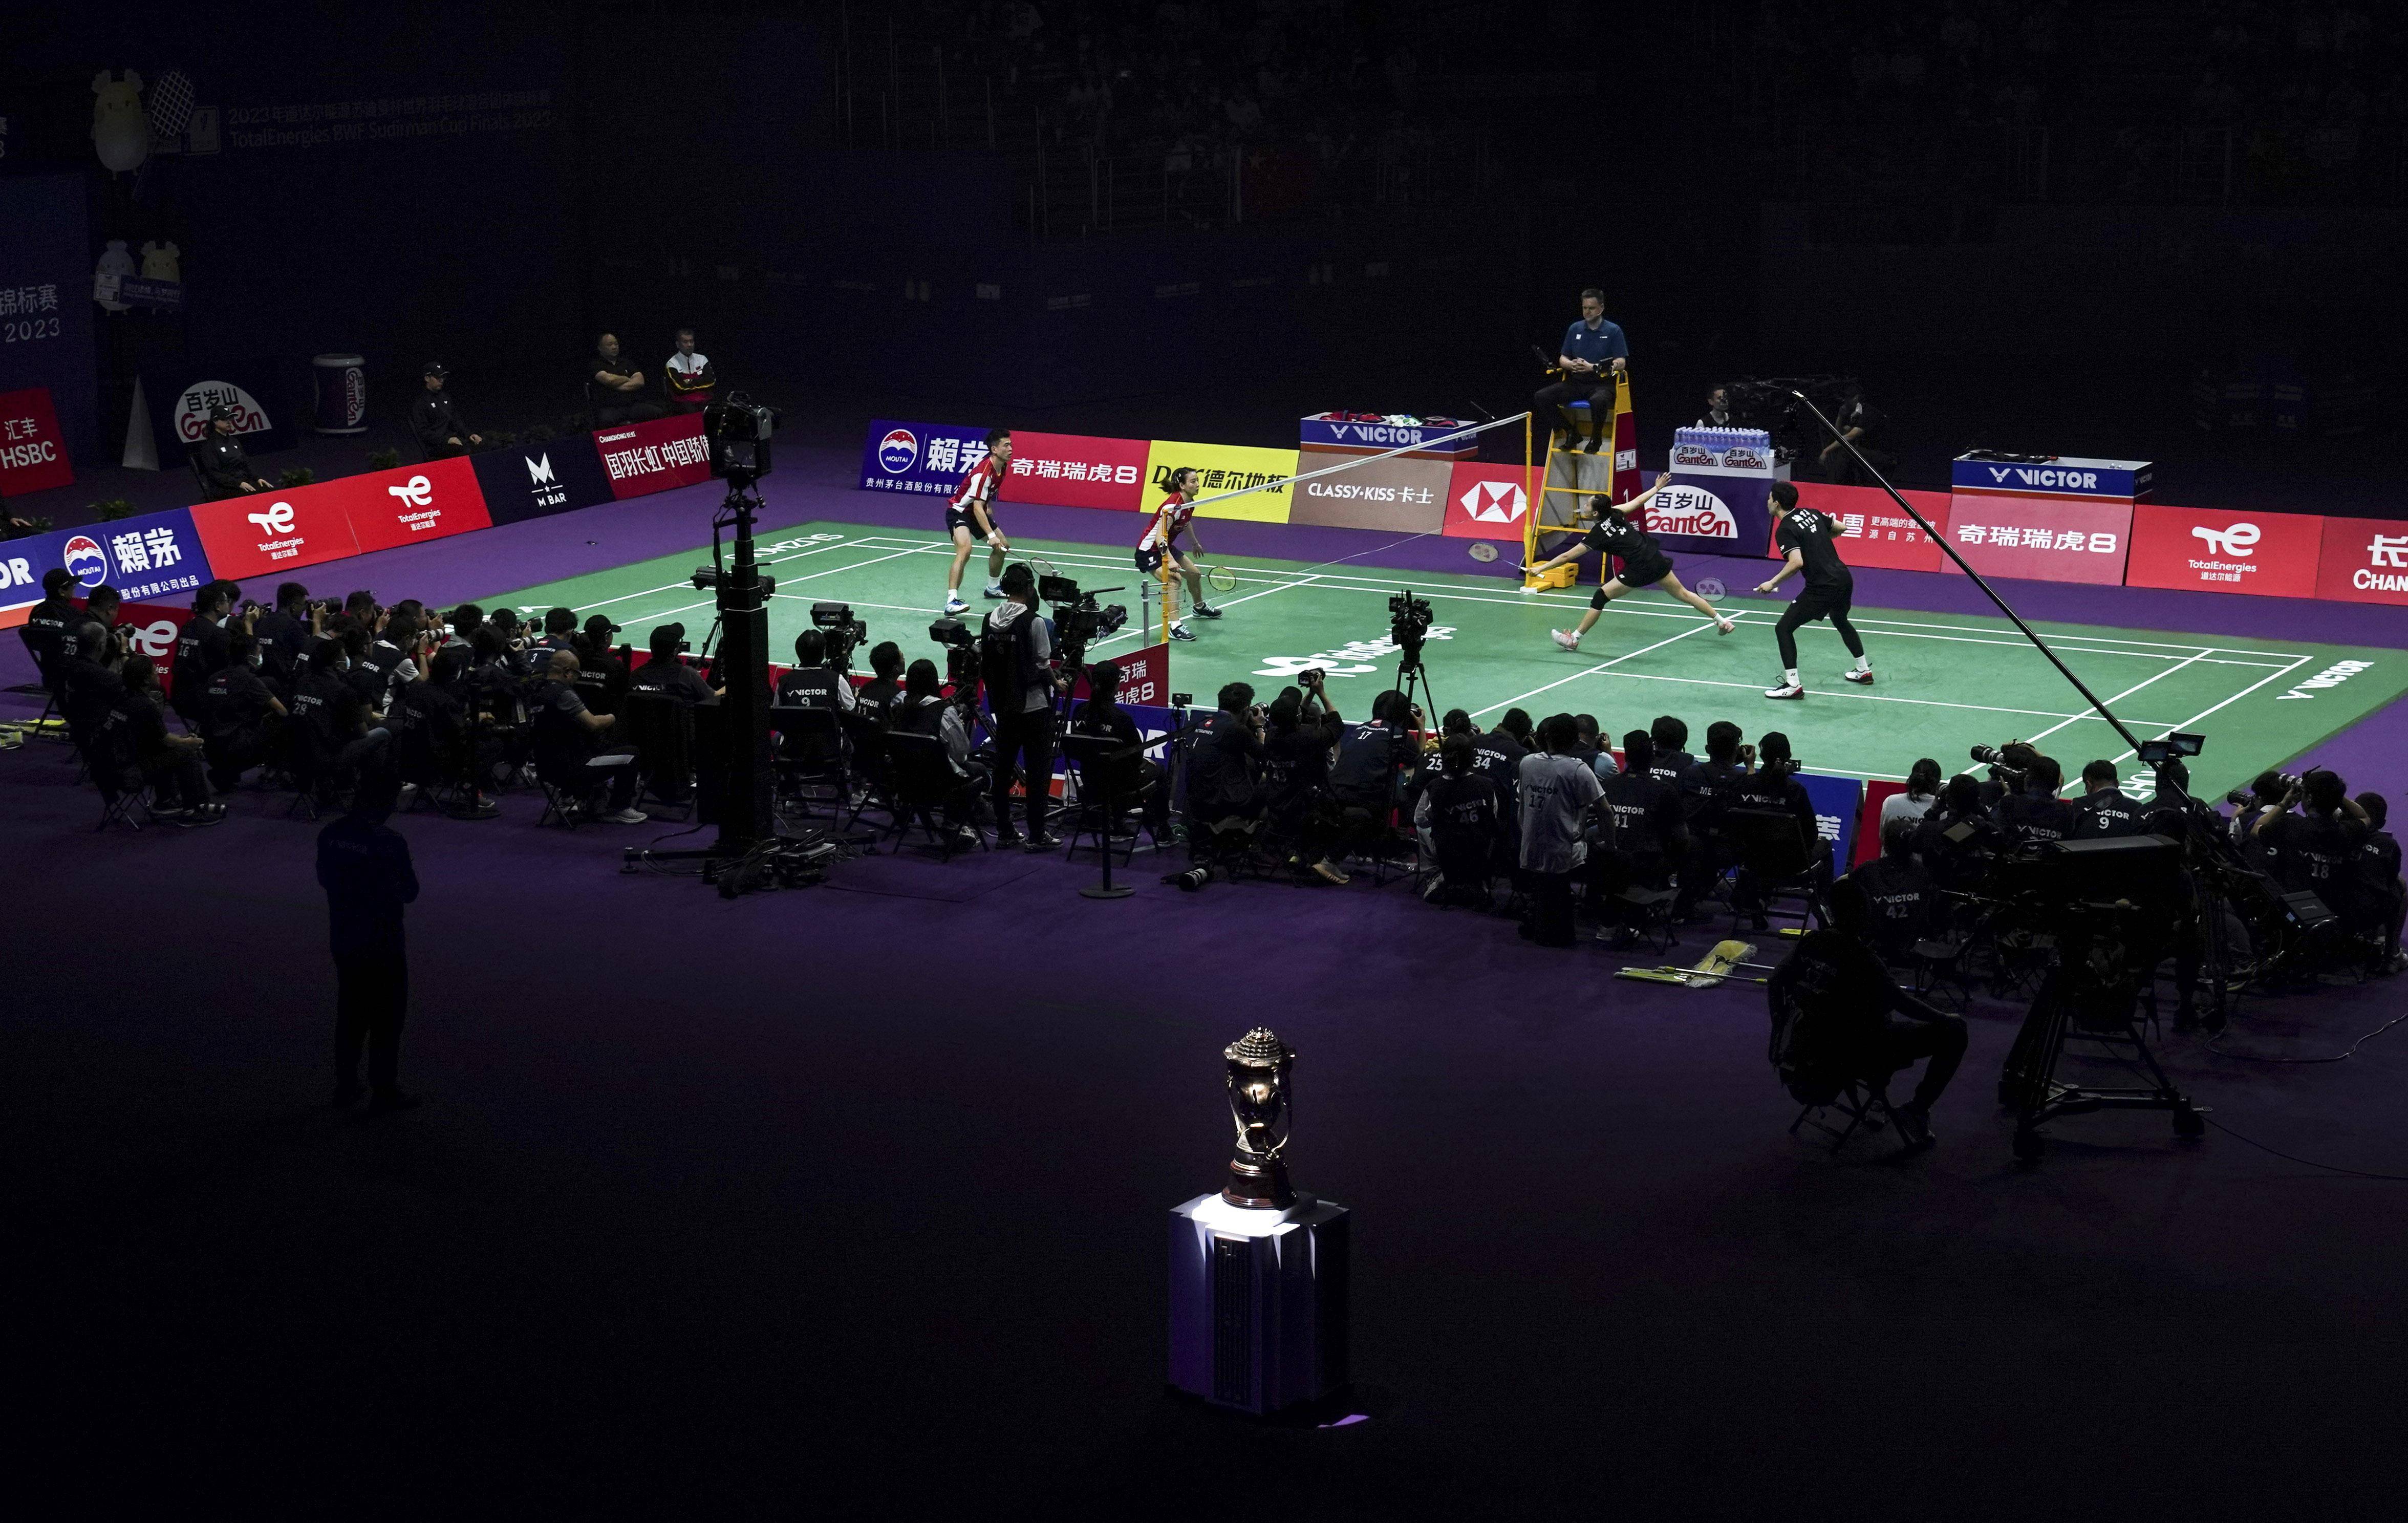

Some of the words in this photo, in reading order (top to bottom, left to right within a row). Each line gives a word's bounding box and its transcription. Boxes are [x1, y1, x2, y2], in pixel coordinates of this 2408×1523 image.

[5, 317, 59, 342] 2023
[185, 388, 239, 412] 百岁山
[4, 417, 38, 440] 汇丰
[1353, 425, 1423, 444] VICTOR
[0, 441, 56, 469] HSBC
[1682, 446, 1705, 455] 百岁山
[1011, 458, 1137, 484] 奇瑞瑞虎8
[2015, 468, 2097, 489] VICTOR
[537, 497, 546, 507] M
[547, 493, 567, 506] BAR
[1397, 486, 1434, 504] 卡士
[1655, 492, 1713, 510] 百岁山
[398, 509, 441, 524] TotalEnergies
[257, 537, 304, 552] TotalEnergies
[1957, 524, 2117, 553] 奇瑞瑞虎8
[77, 566, 101, 576] MOUTAI
[2188, 560, 2257, 573] TotalEnergies
[2200, 571, 2241, 582] 道达尔能源
[531, 652, 538, 662] 3
[801, 697, 810, 707] 9
[1358, 731, 1372, 740] 17
[1473, 756, 1491, 769] 34
[1475, 748, 1507, 762] VICTOR
[1426, 758, 1443, 771] 25
[1529, 795, 1545, 810] 17
[1612, 804, 1645, 816] VICTOR
[1459, 810, 1479, 824] 46
[1614, 813, 1629, 828] 41
[2099, 817, 2110, 829] 9
[2028, 825, 2062, 840] VICTOR
[2311, 863, 2329, 879] 18
[1883, 892, 1921, 904] VICTOR
[1886, 904, 1908, 919] 42
